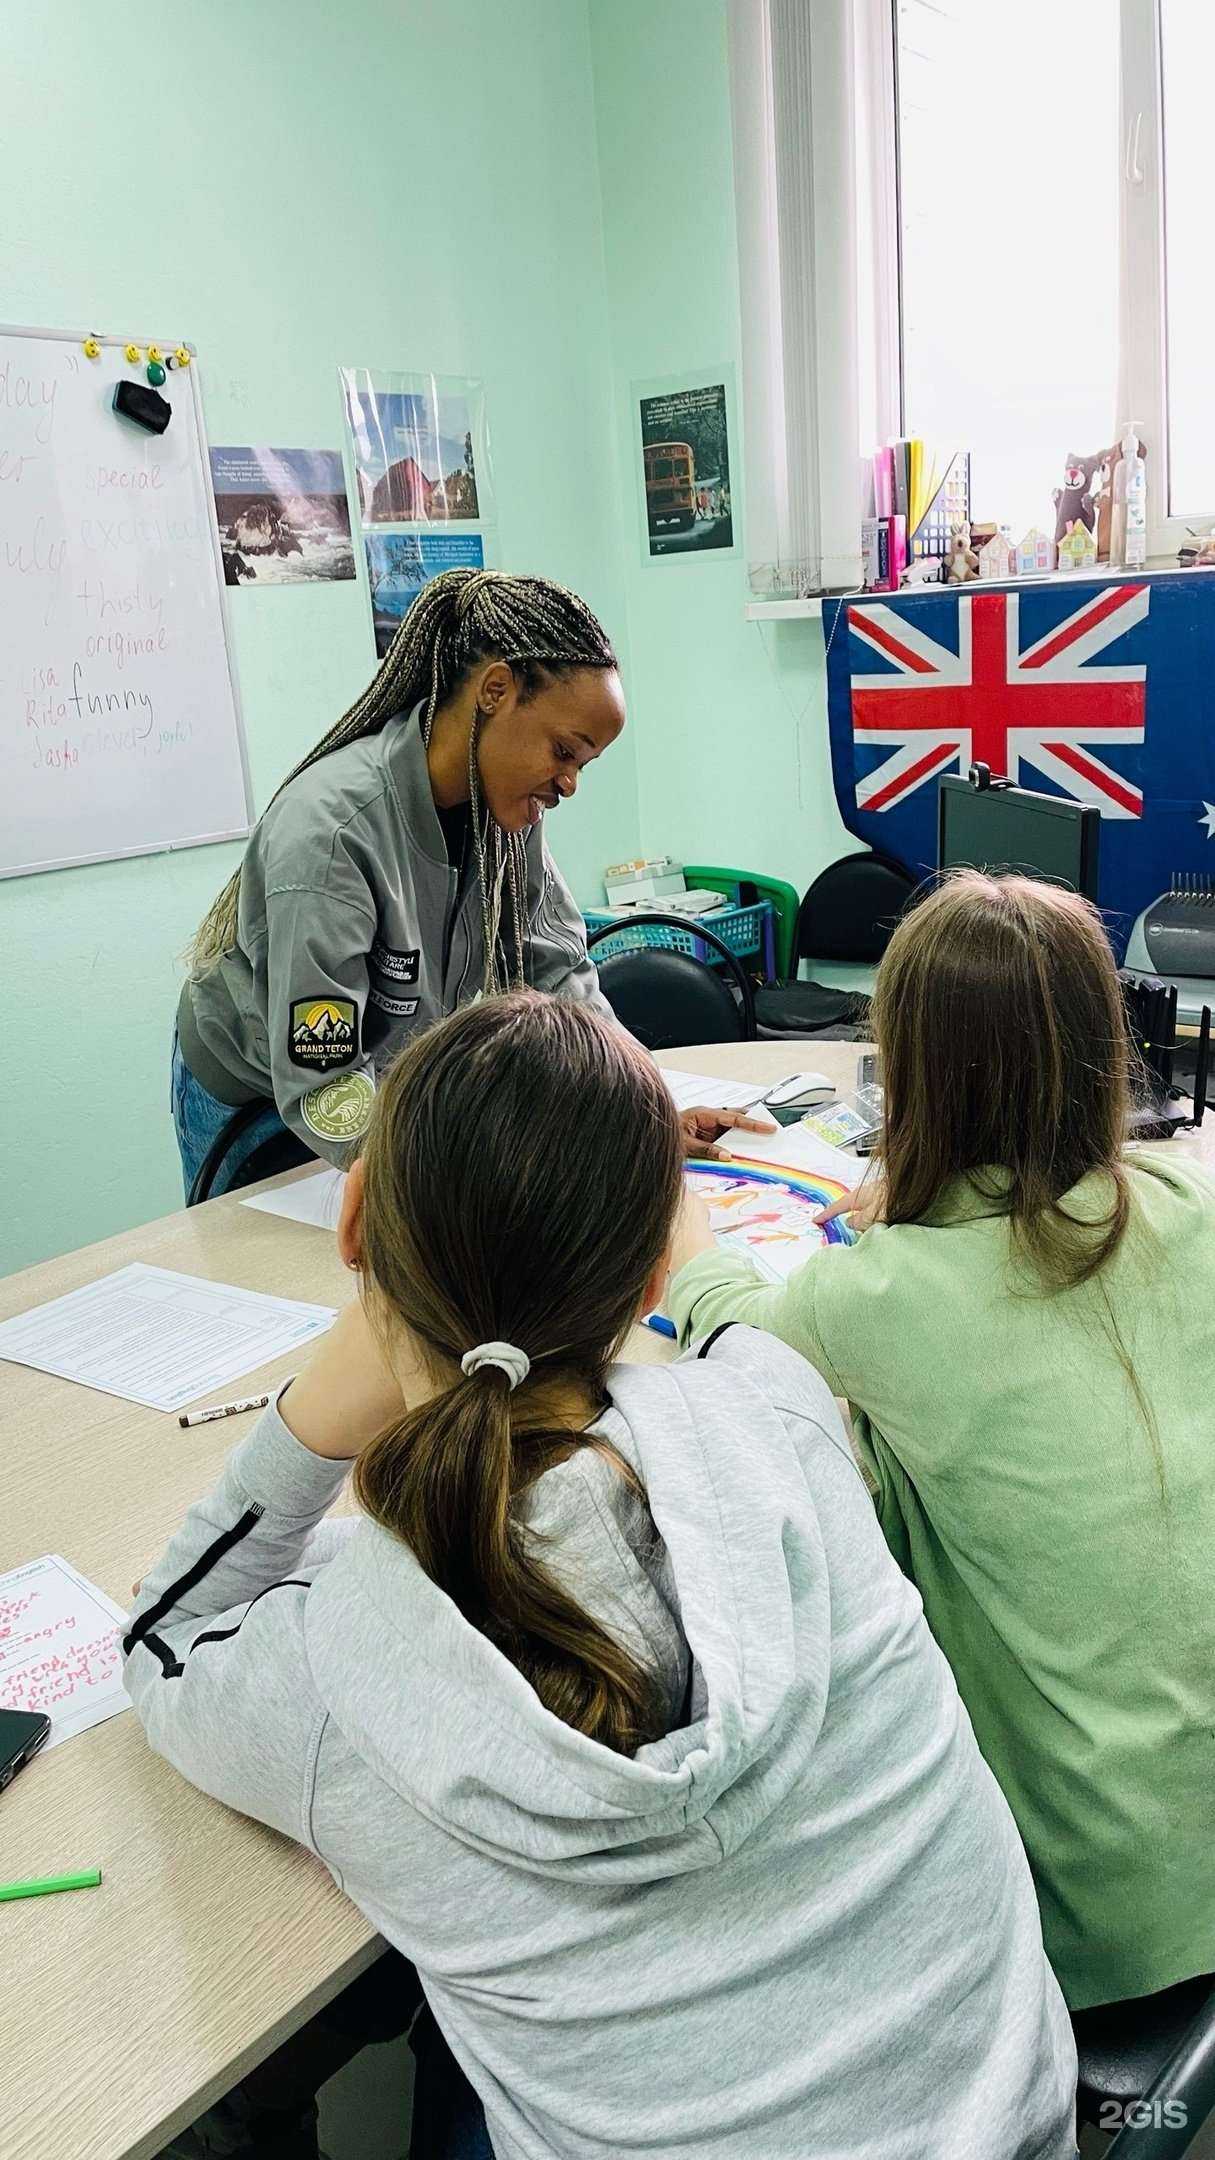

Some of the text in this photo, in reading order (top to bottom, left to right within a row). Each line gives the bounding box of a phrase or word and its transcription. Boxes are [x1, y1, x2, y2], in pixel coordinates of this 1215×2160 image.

[86, 627, 168, 672] original
[66, 661, 154, 741] funny
[295, 1044, 353, 1054] GRAND TETON
[23, 1615, 76, 1644] angry
[4, 1655, 62, 1687] friend
[84, 1670, 113, 1688] to
